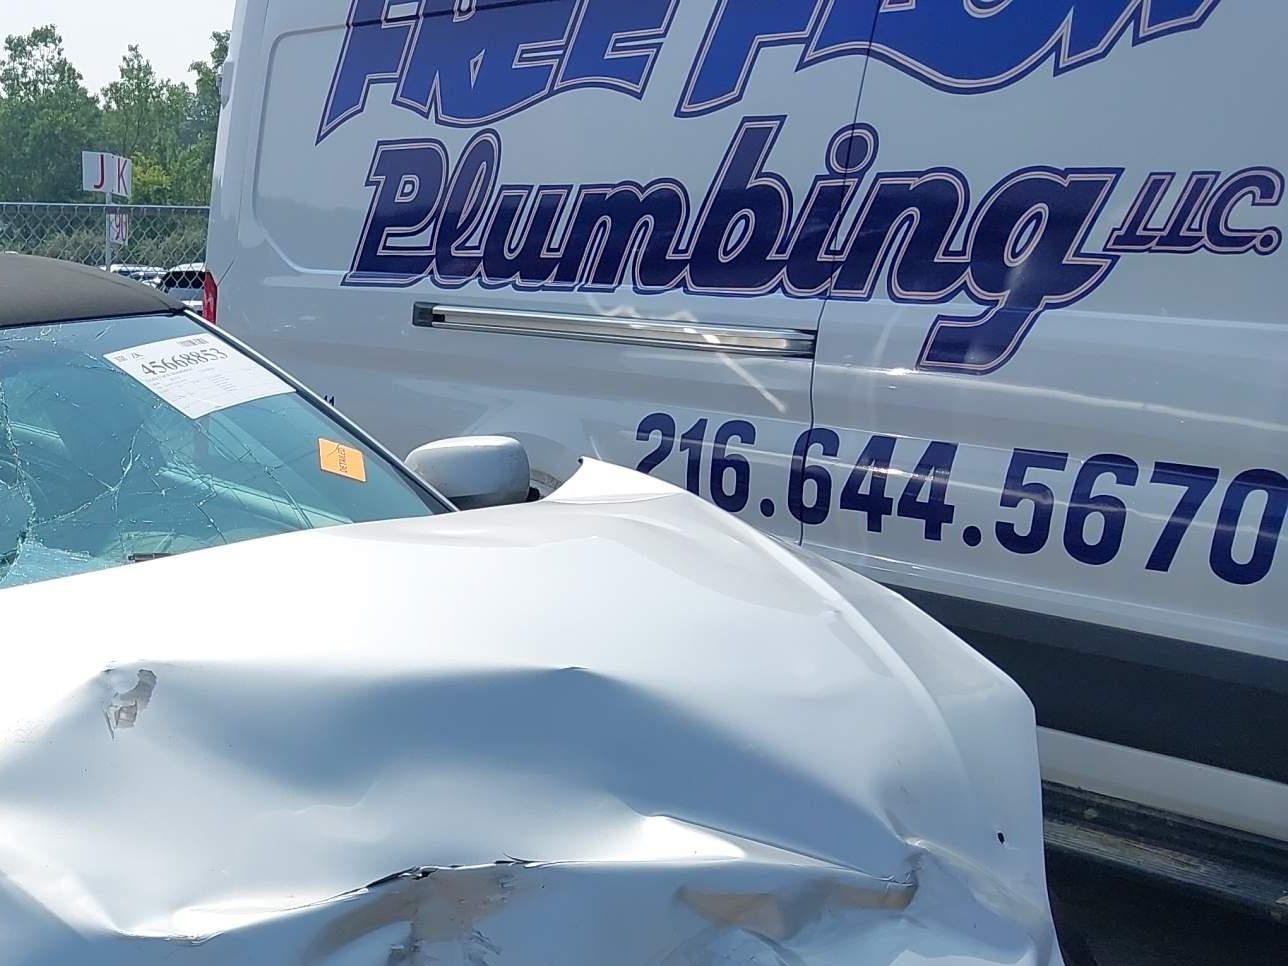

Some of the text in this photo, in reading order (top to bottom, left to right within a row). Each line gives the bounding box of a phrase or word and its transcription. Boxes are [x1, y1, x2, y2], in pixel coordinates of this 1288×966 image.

[94, 154, 129, 195] J K
[342, 115, 1286, 374] Plumbing LLC.
[141, 347, 229, 376] 45668853
[636, 412, 1288, 585] 216.644.5670
